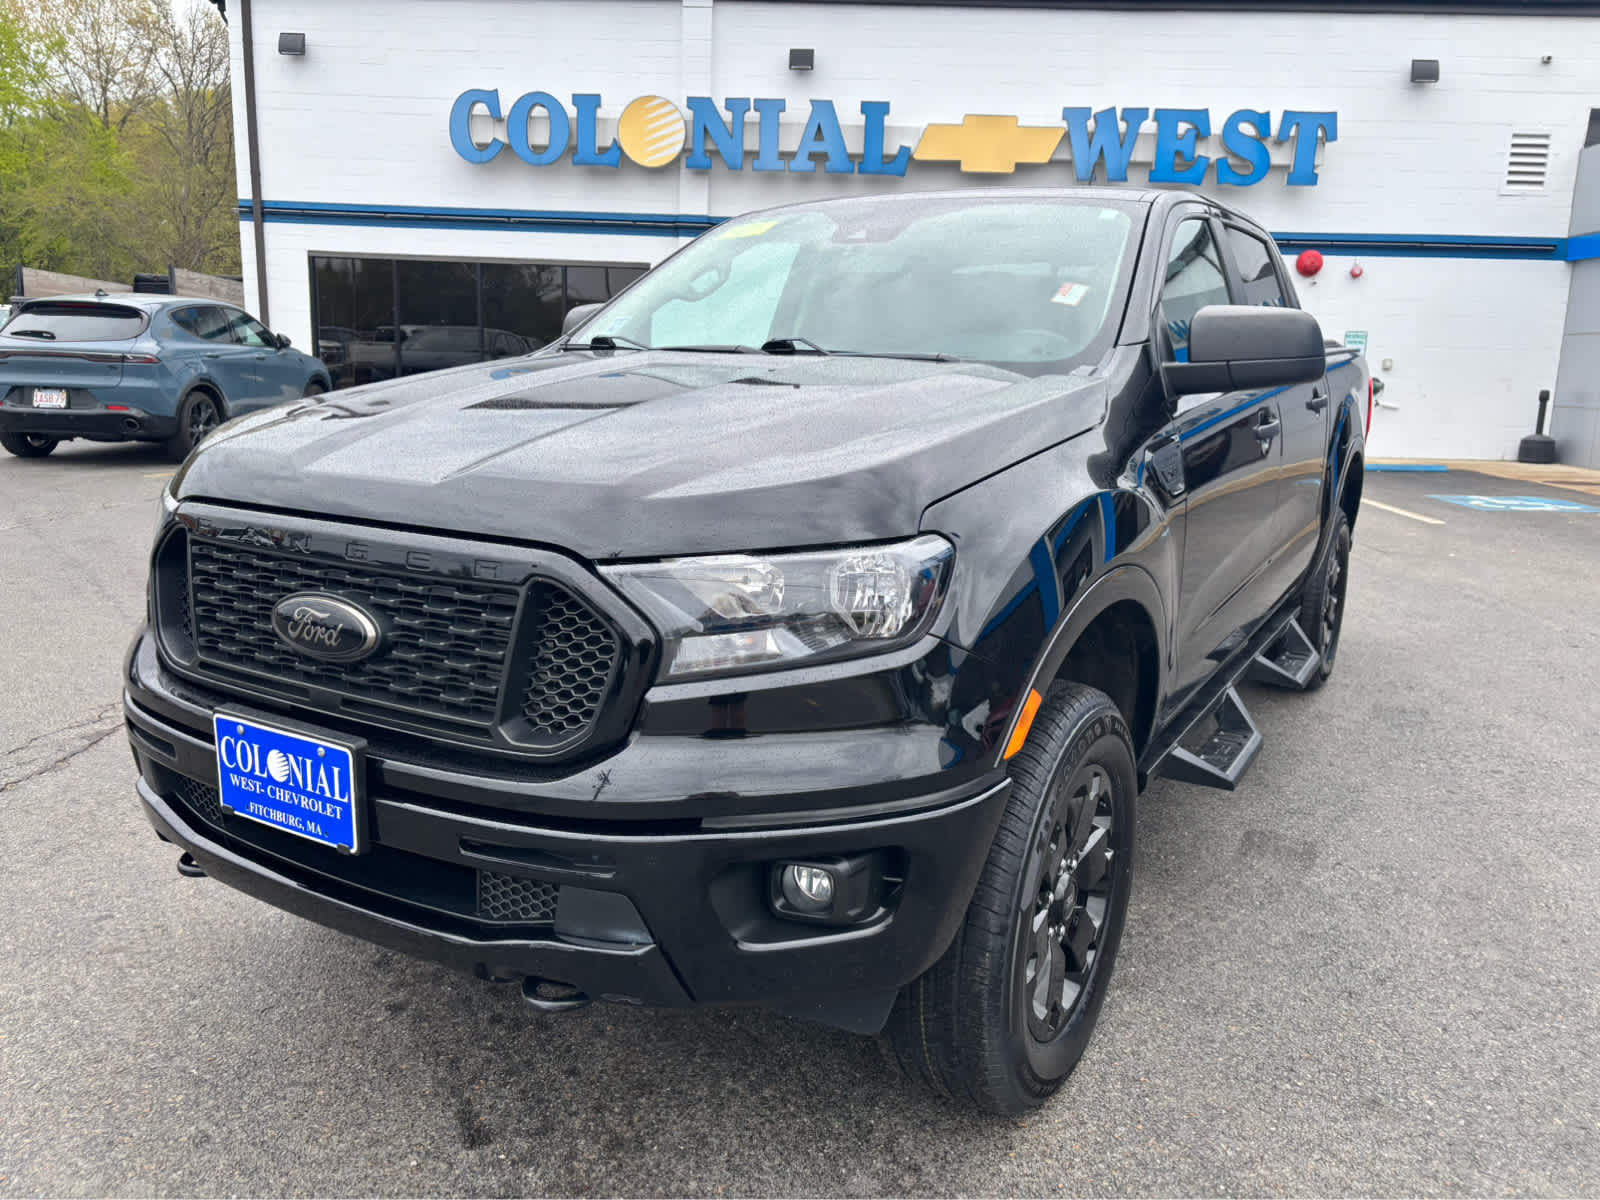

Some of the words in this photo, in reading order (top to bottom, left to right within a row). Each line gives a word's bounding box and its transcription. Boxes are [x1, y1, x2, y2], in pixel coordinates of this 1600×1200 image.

[449, 88, 912, 177] COLONIAL
[1062, 106, 1338, 186] WEST
[288, 606, 344, 647] Ford
[220, 735, 349, 803] COLONIAL
[249, 801, 305, 832] FITCHBURG,
[307, 820, 322, 836] MA
[267, 785, 343, 820] CHEVROLET
